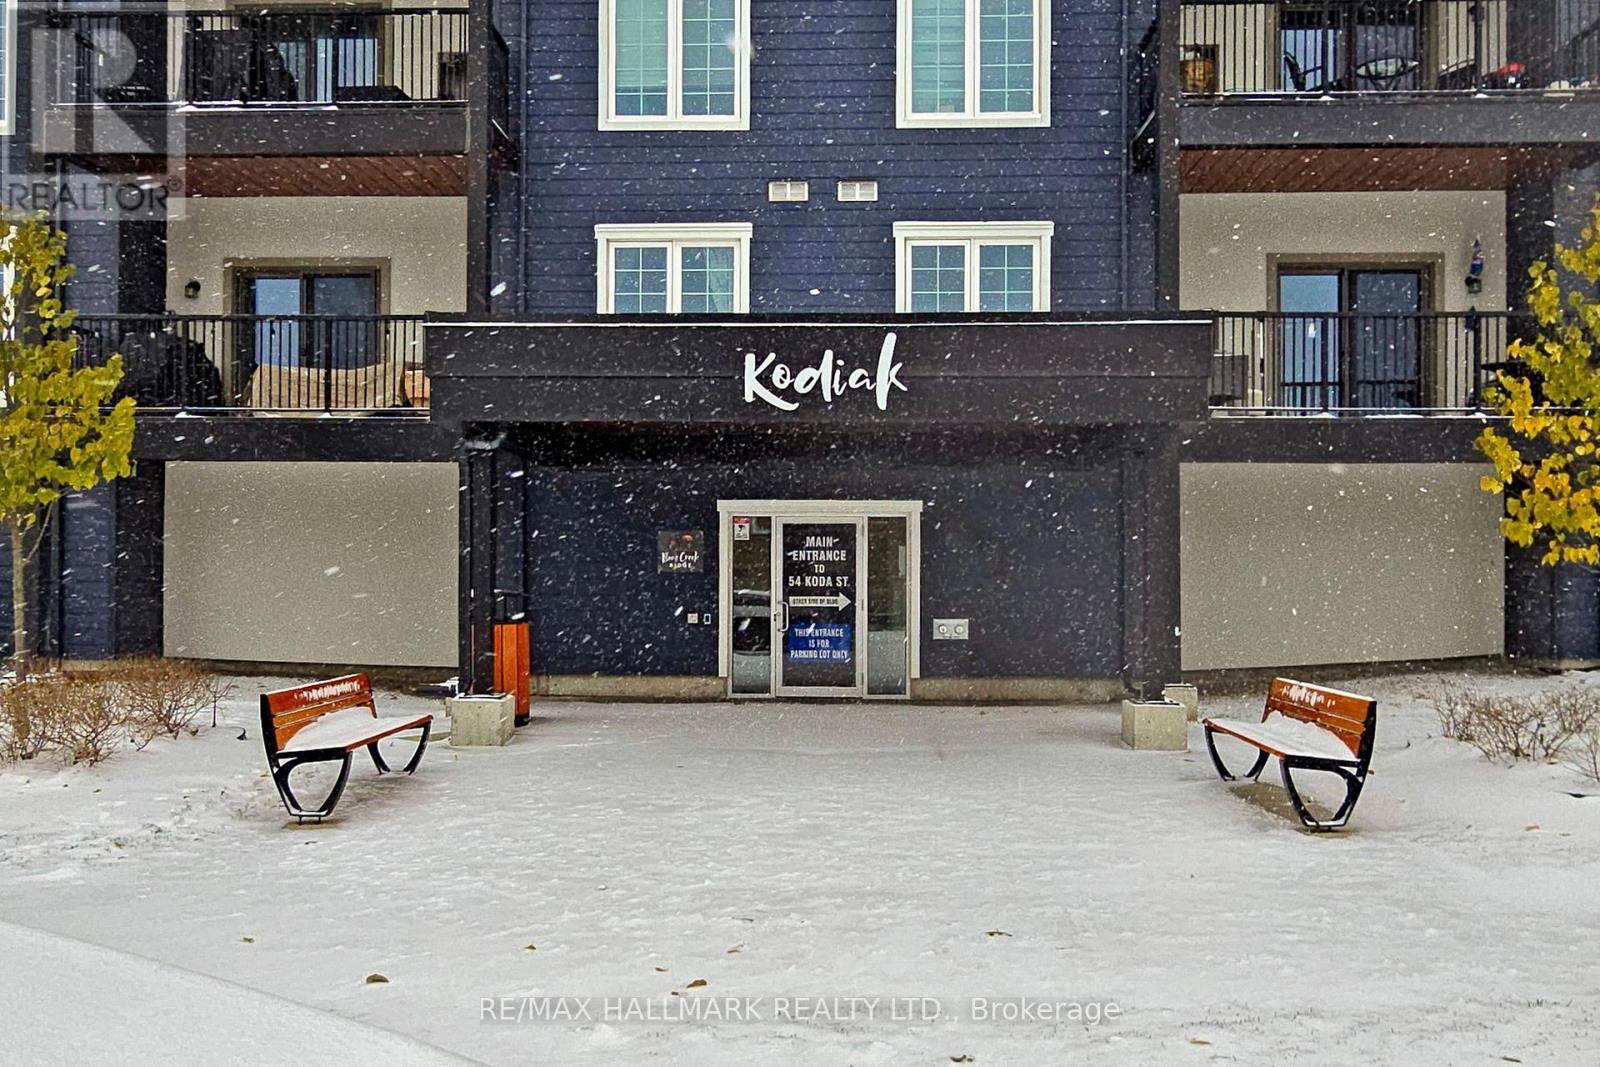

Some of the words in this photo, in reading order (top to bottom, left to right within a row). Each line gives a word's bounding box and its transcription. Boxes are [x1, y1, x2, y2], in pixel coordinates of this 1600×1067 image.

[744, 332, 908, 411] Kodiak
[805, 536, 833, 547] MAIN
[792, 550, 847, 561] ENTRANCE
[814, 564, 825, 573] TO
[788, 576, 801, 587] 54
[804, 576, 833, 587] KODA
[794, 628, 811, 637] THIS
[811, 628, 844, 637] ENTRANCE
[808, 639, 816, 648] IS
[817, 639, 830, 648] FOR
[790, 650, 818, 659] PARKING
[819, 650, 831, 659] LOT
[832, 650, 848, 659] ONLY
